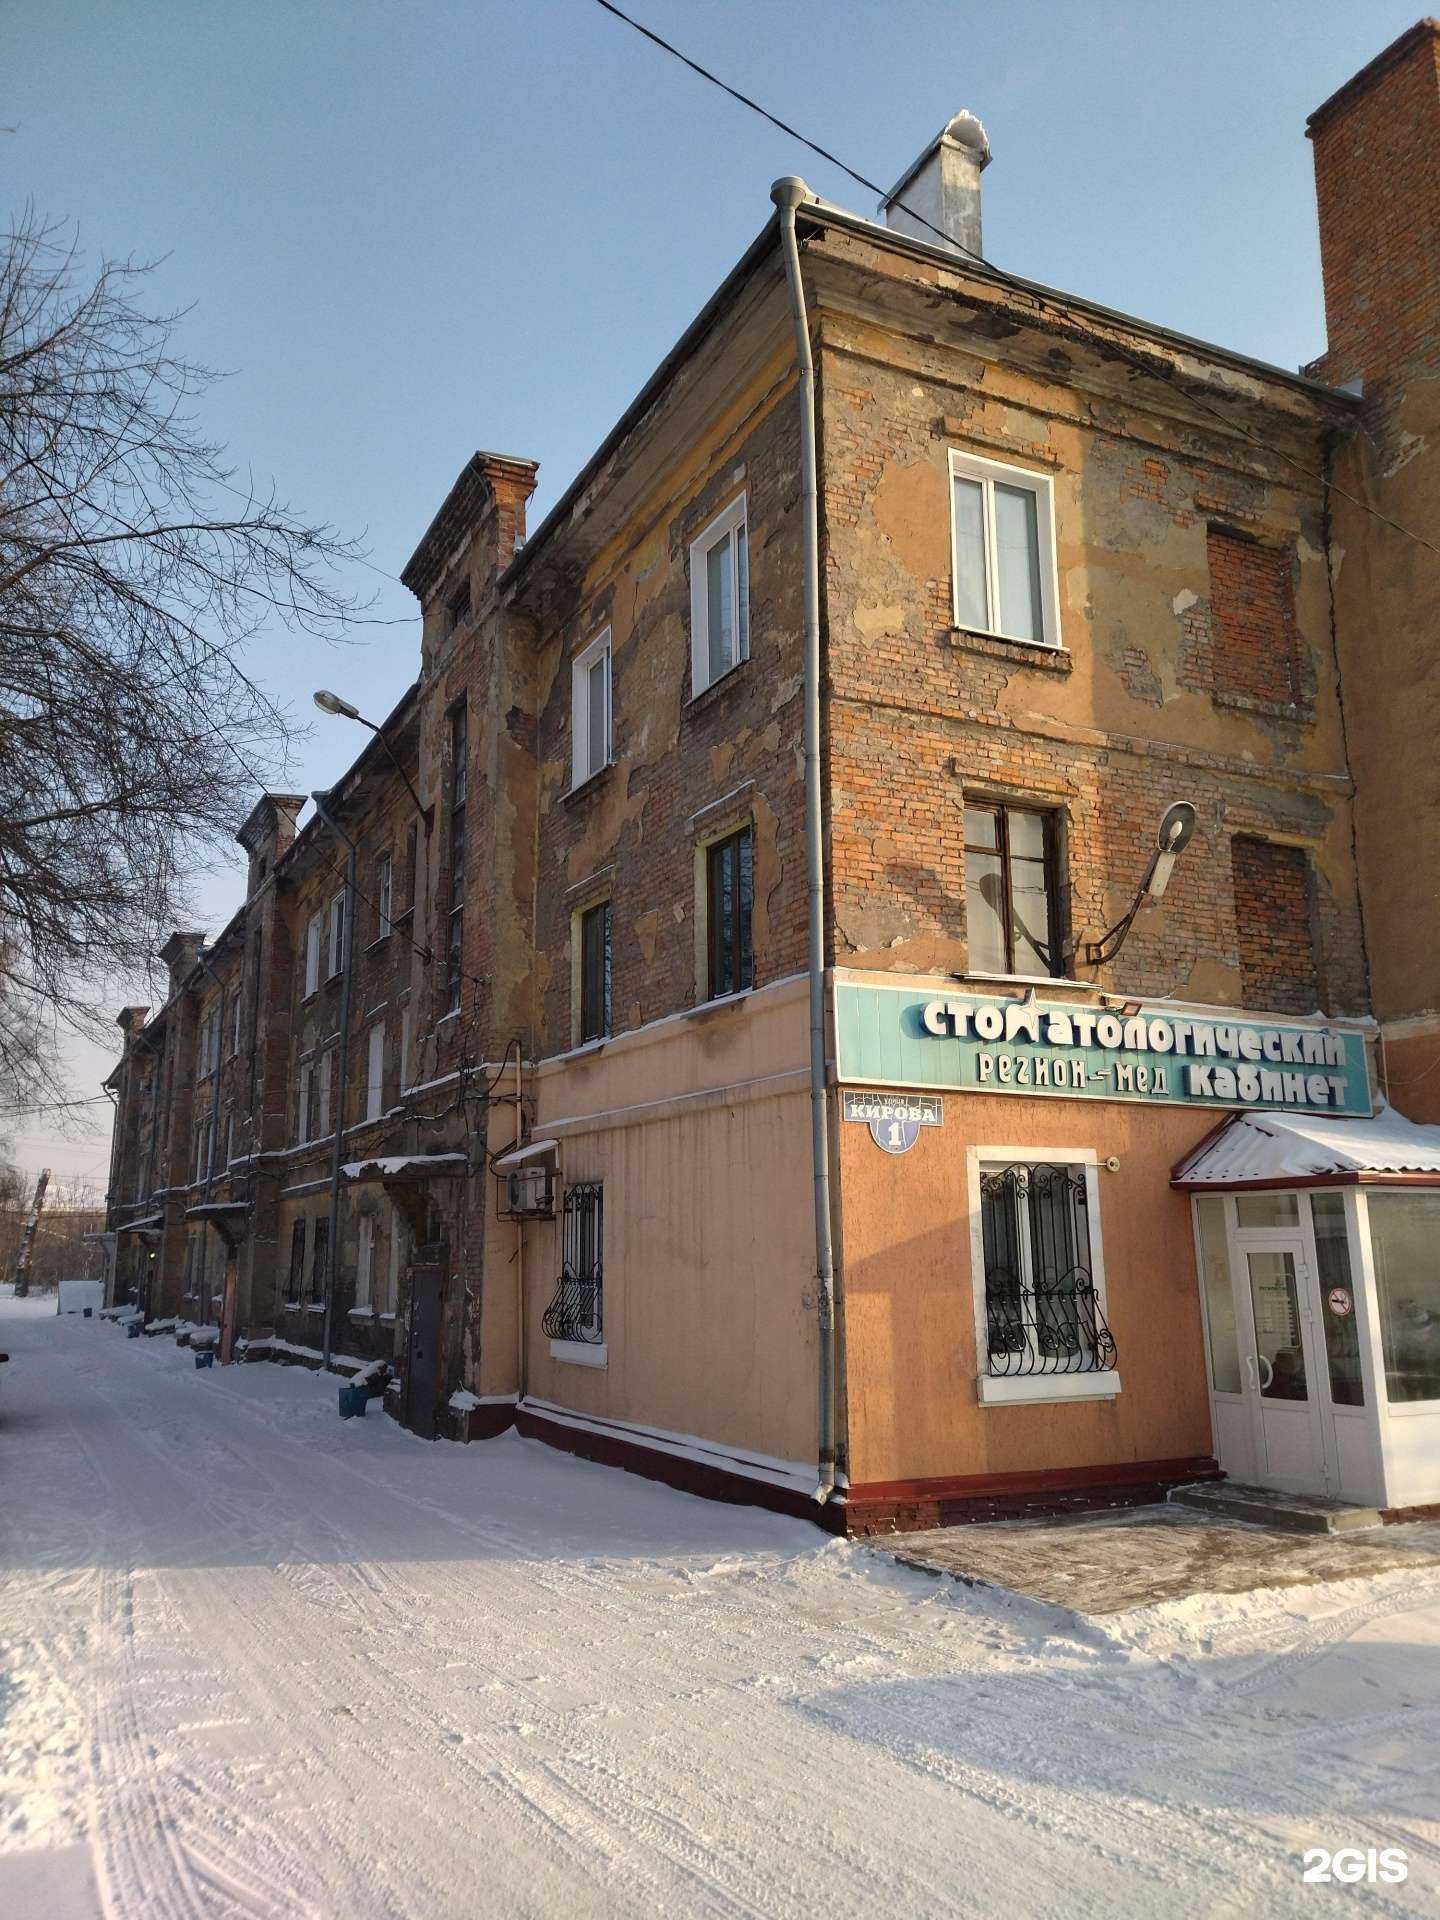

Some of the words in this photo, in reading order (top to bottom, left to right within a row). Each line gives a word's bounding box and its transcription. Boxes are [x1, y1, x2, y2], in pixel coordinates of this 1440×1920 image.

[1187, 1063, 1348, 1106] кабинет
[850, 1104, 936, 1122] КИРОВА
[888, 1122, 902, 1146] 1
